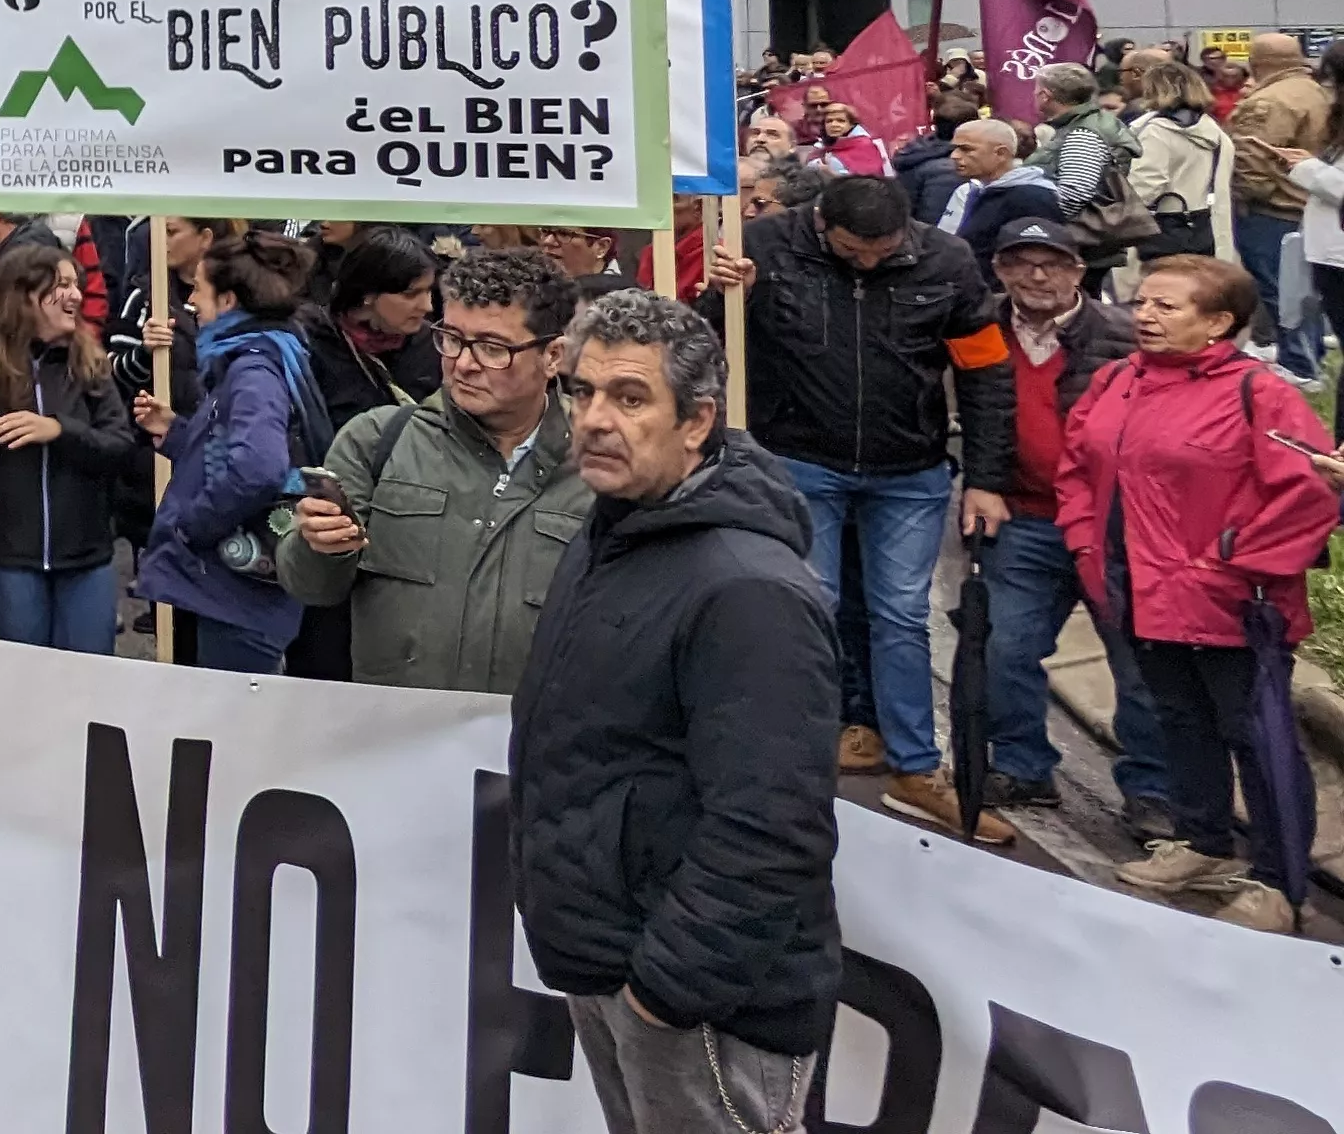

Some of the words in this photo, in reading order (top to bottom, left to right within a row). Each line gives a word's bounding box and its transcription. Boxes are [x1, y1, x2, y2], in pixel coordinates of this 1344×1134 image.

[83, 1, 125, 24] POR
[130, 0, 163, 24] EL
[465, 97, 610, 135] BIEN
[0, 127, 117, 143] PLATAFORMA
[0, 143, 48, 158] PARA
[52, 143, 74, 158] LA
[80, 144, 165, 159] DEFENSA
[0, 158, 33, 173] DE
[38, 158, 58, 173] LA
[57, 159, 171, 174] CORDILLERA
[376, 140, 614, 187] QUIEN?
[1, 170, 114, 189] CANTÁBRICA
[64, 720, 357, 1134] NO
